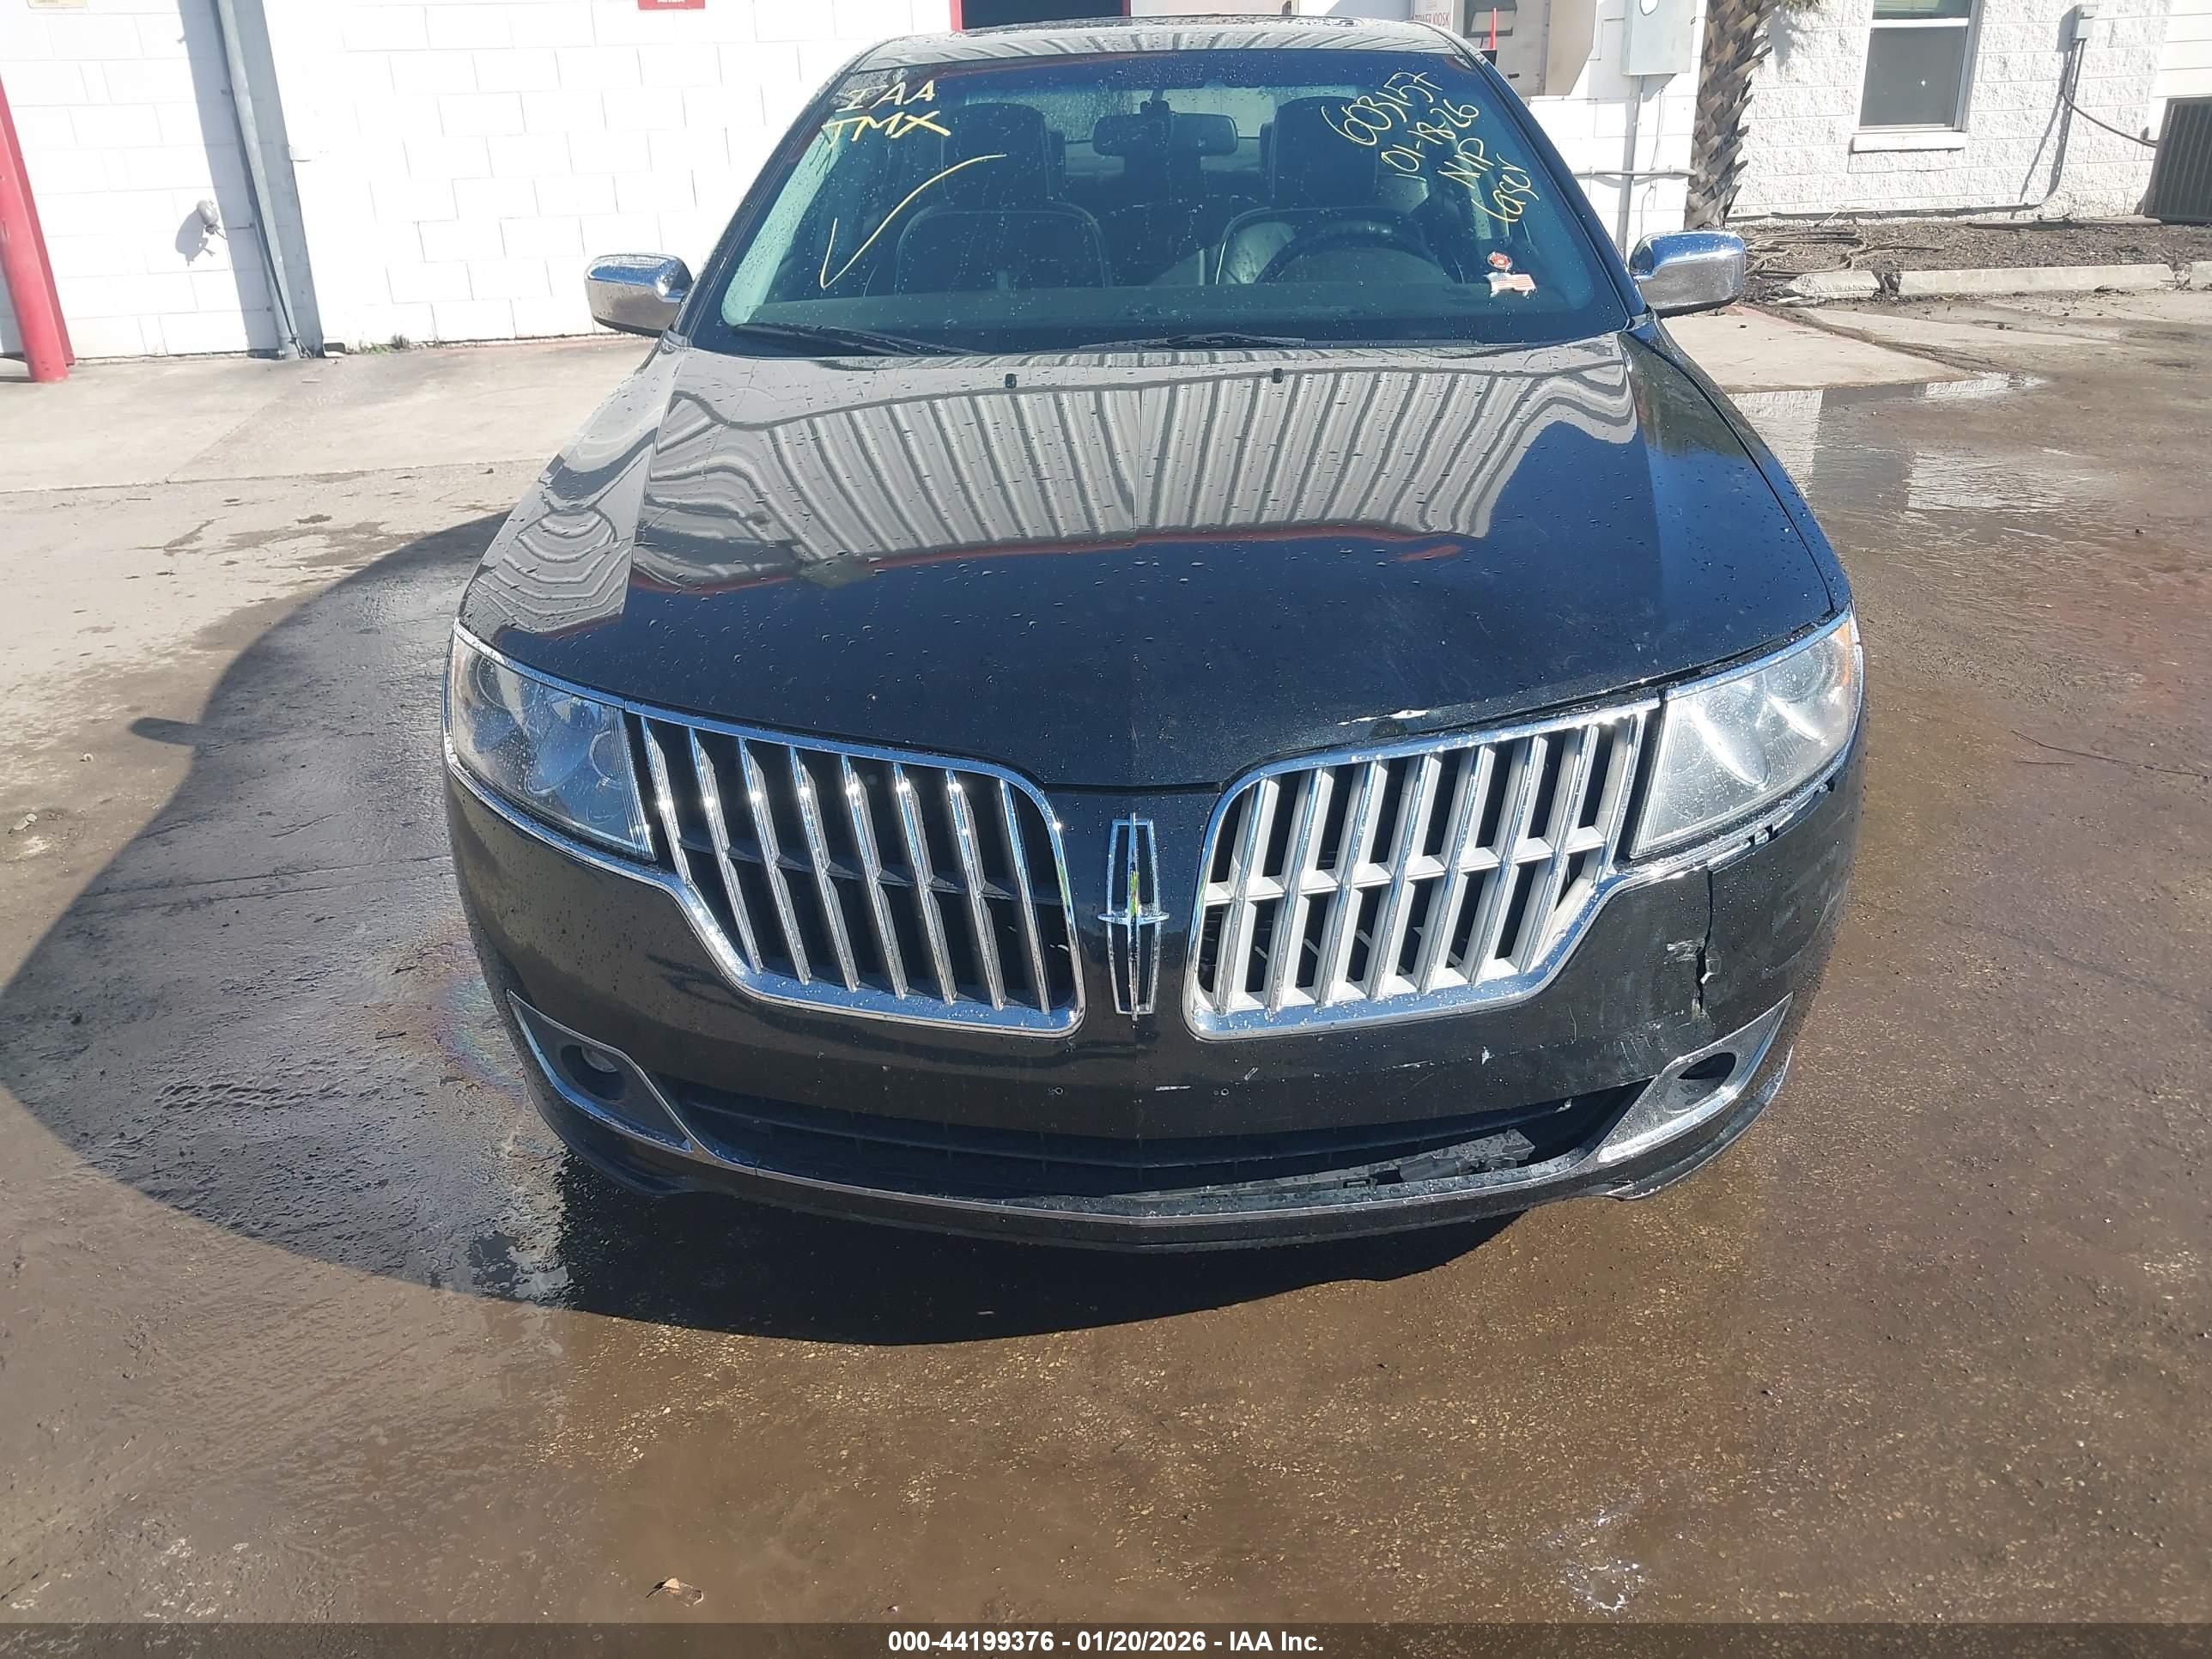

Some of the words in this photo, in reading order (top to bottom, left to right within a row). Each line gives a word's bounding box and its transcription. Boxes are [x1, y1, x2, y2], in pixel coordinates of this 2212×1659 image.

[1433, 11, 1450, 27] KIOSK
[835, 79, 936, 113] IAA
[1321, 71, 1443, 146] 603157
[1380, 99, 1480, 173] 01-18-26
[1437, 137, 1495, 190] NIP
